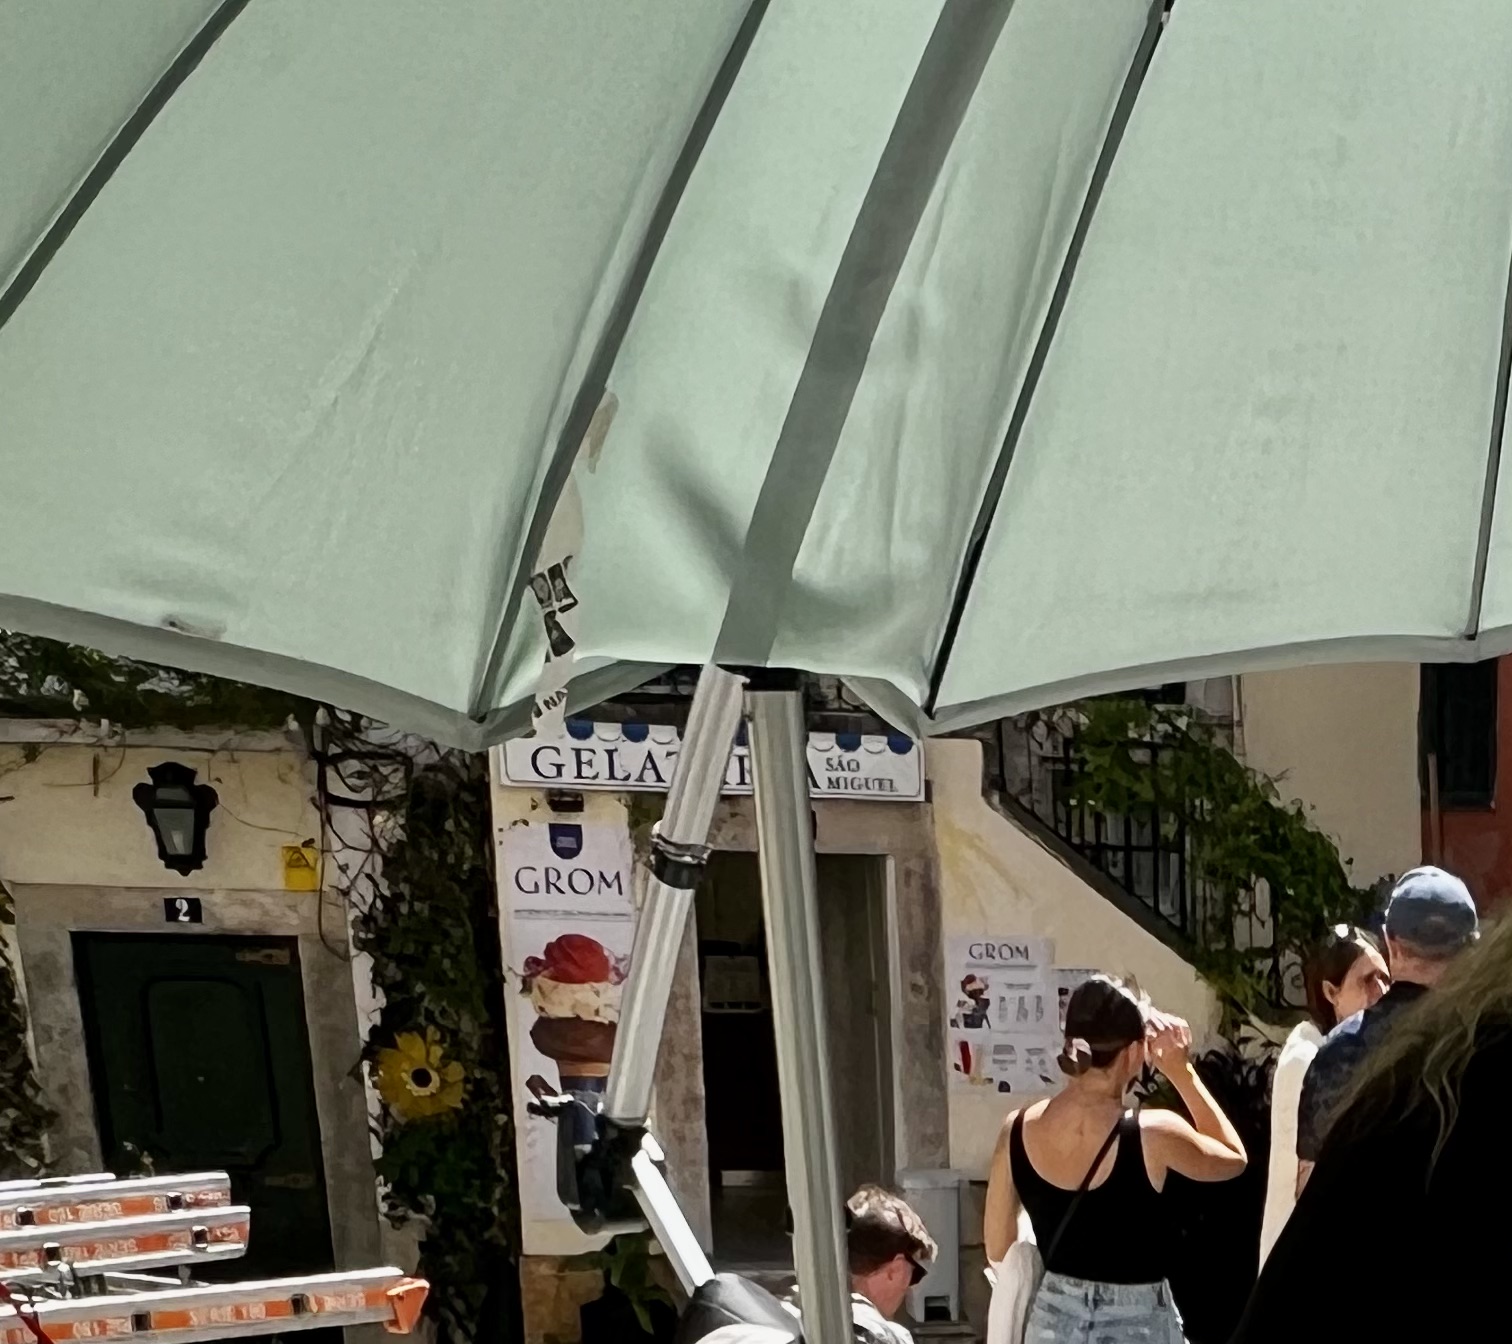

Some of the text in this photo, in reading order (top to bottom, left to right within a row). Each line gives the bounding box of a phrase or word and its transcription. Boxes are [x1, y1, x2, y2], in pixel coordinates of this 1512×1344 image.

[826, 775, 899, 793] MIGUEL
[514, 866, 624, 896] GROM
[175, 898, 190, 922] 2
[968, 943, 1030, 961] GROM
